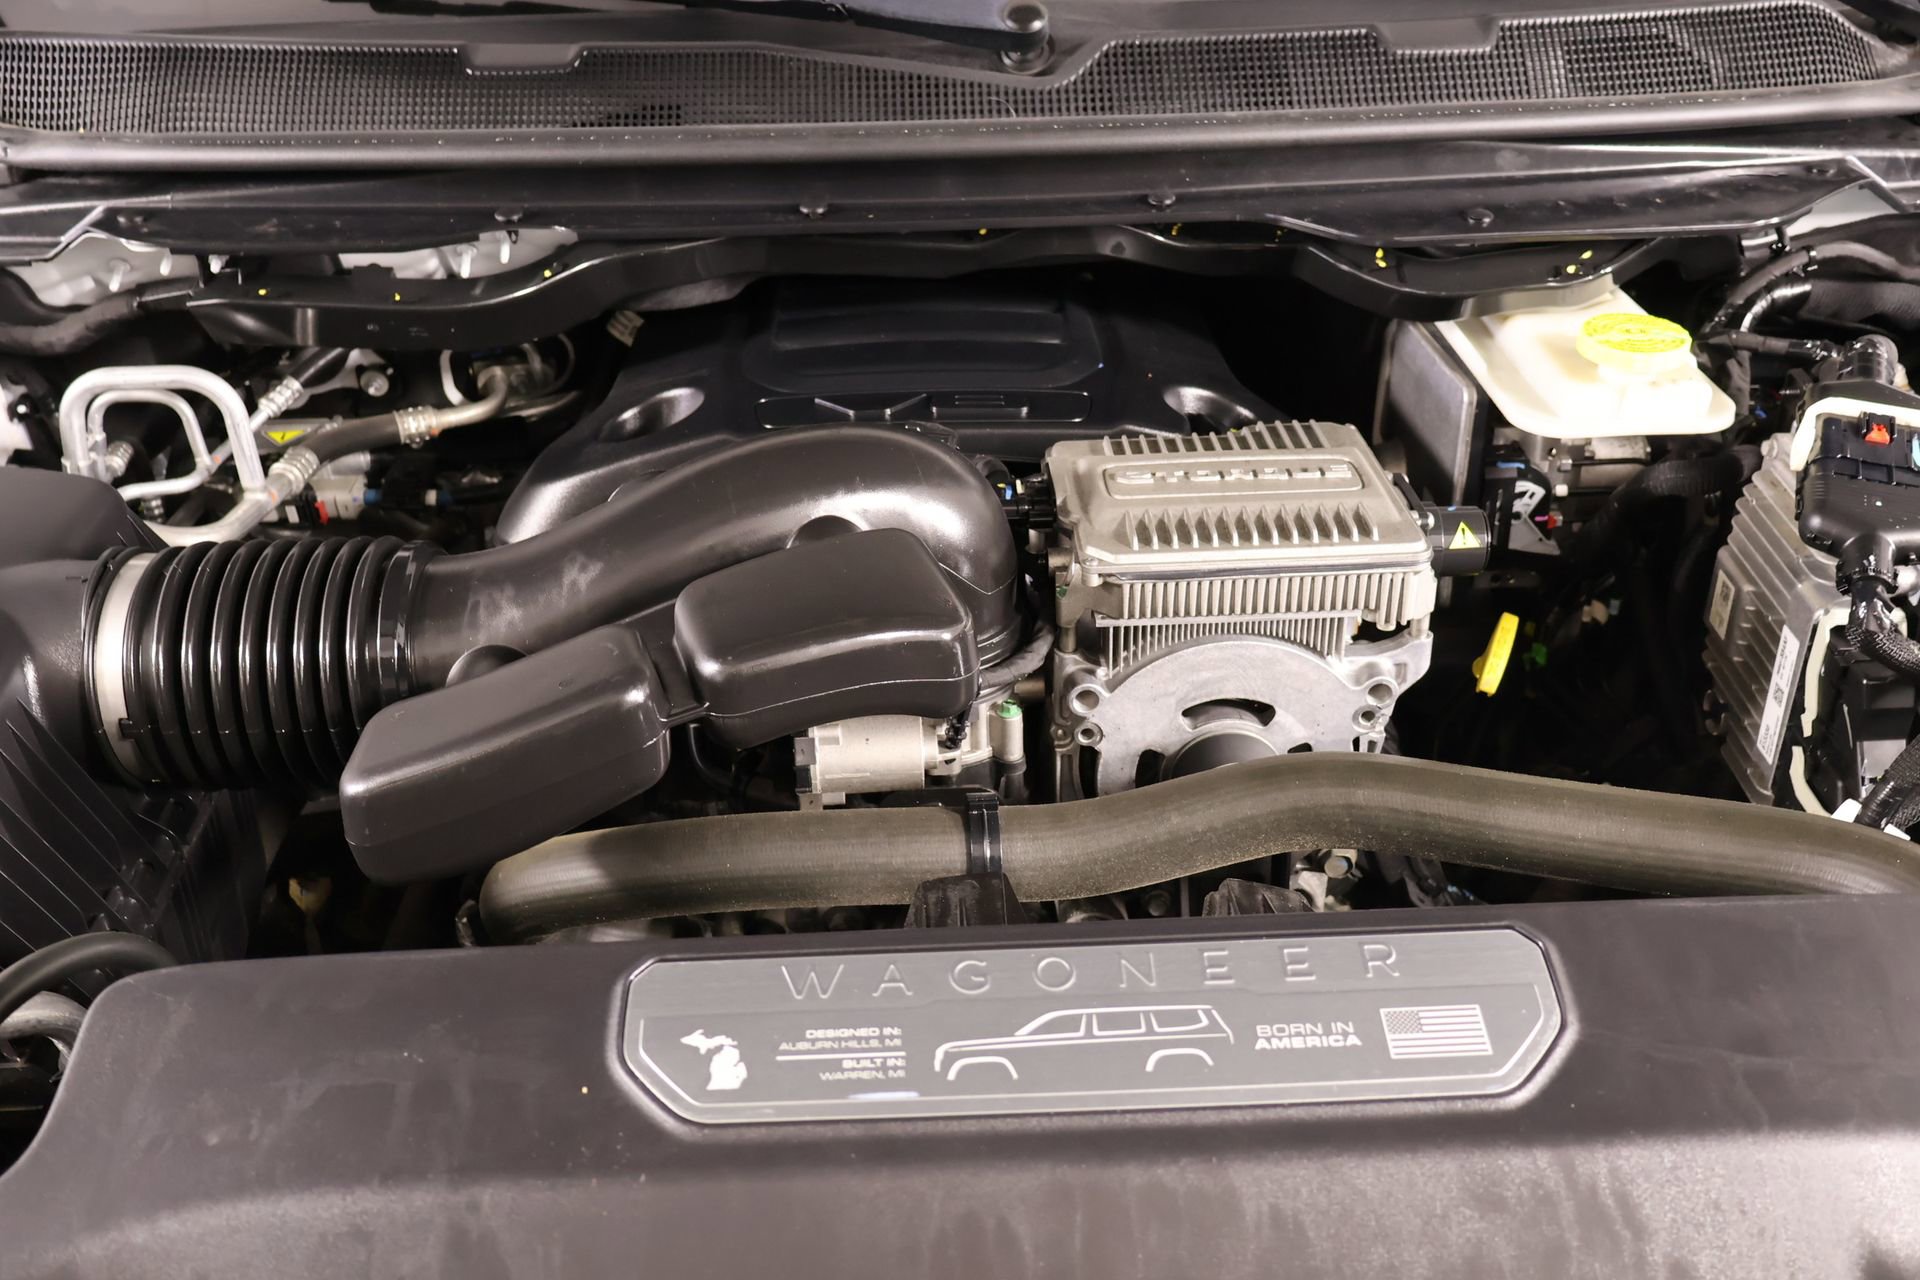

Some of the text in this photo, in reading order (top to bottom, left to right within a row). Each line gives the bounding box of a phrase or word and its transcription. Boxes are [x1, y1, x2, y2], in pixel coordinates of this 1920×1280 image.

[781, 943, 1401, 1000] WAGONEER
[805, 1027, 880, 1039] DESIGNED
[1255, 1021, 1354, 1037] BORN IN
[779, 1040, 839, 1051] AUBURN
[884, 1038, 902, 1047] MI
[1255, 1034, 1362, 1050] AMERICA
[842, 1058, 884, 1069] BUILT
[888, 1069, 906, 1078] MI
